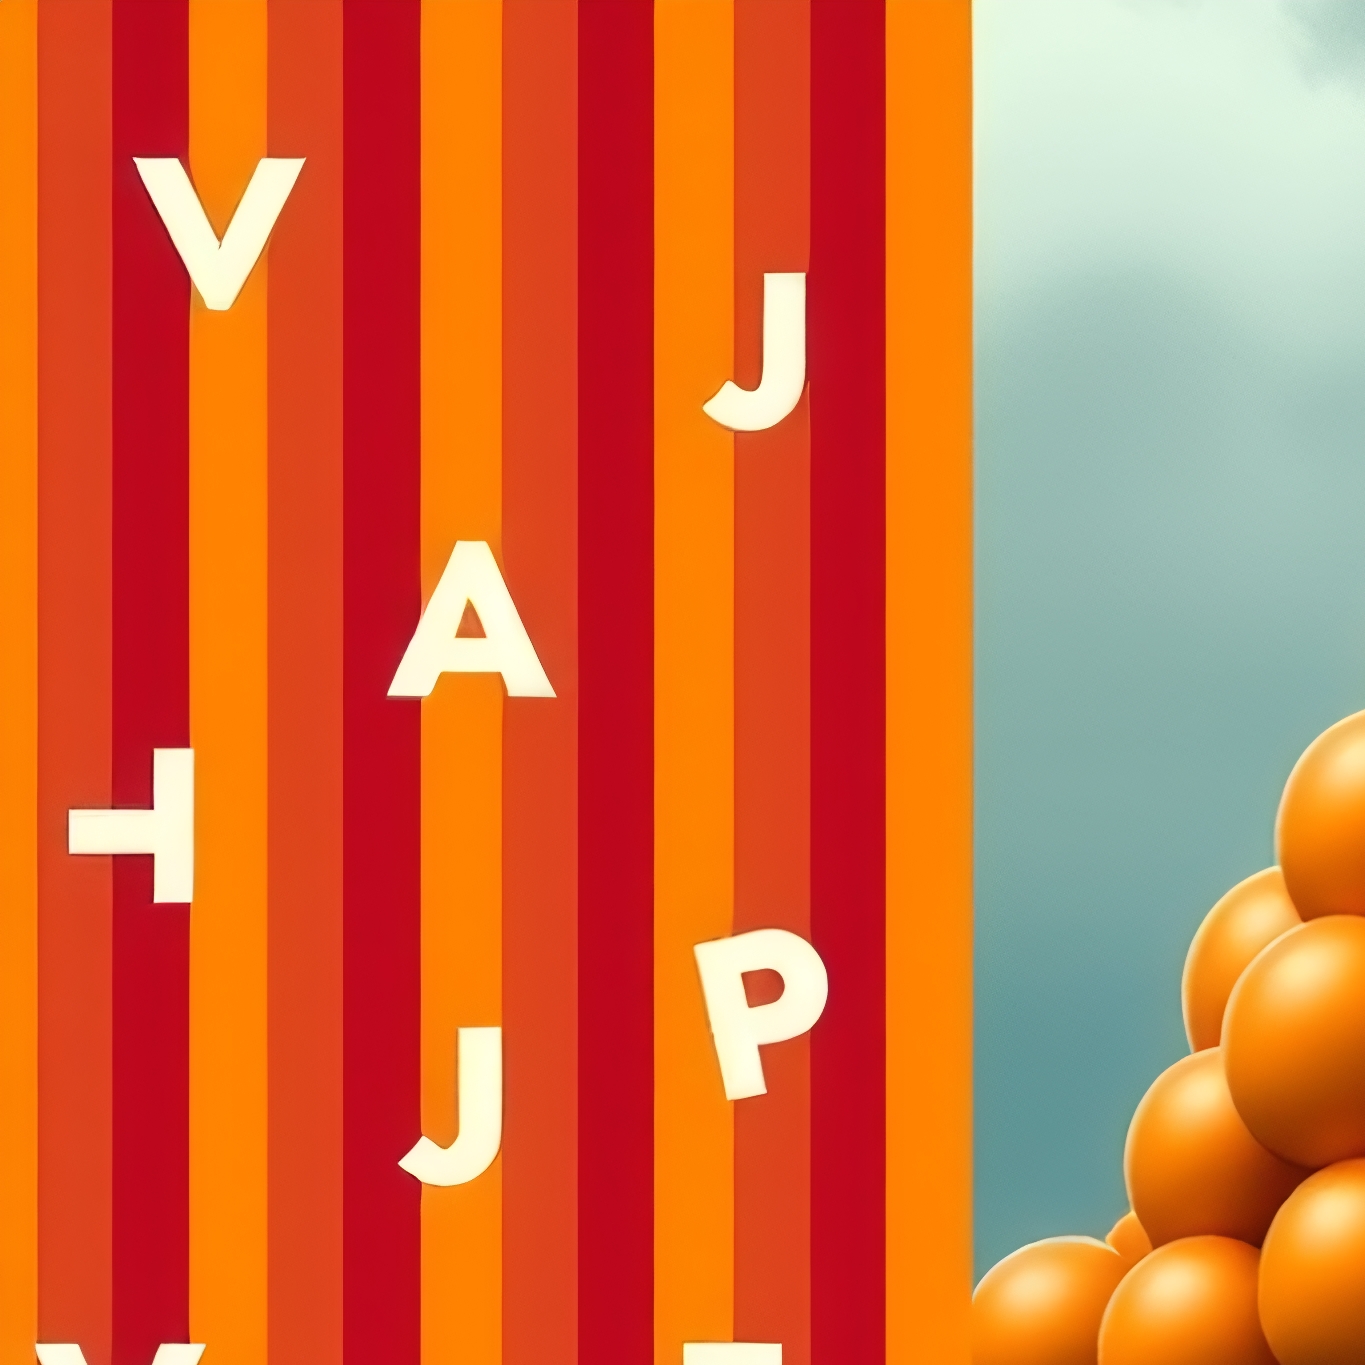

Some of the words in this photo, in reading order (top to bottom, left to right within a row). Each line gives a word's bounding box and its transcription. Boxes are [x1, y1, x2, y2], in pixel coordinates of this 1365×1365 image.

[133, 157, 306, 310] V
[704, 273, 805, 430] J
[388, 541, 556, 697] A
[69, 749, 194, 903] T
[695, 930, 828, 1099] P
[398, 1027, 502, 1186] J
